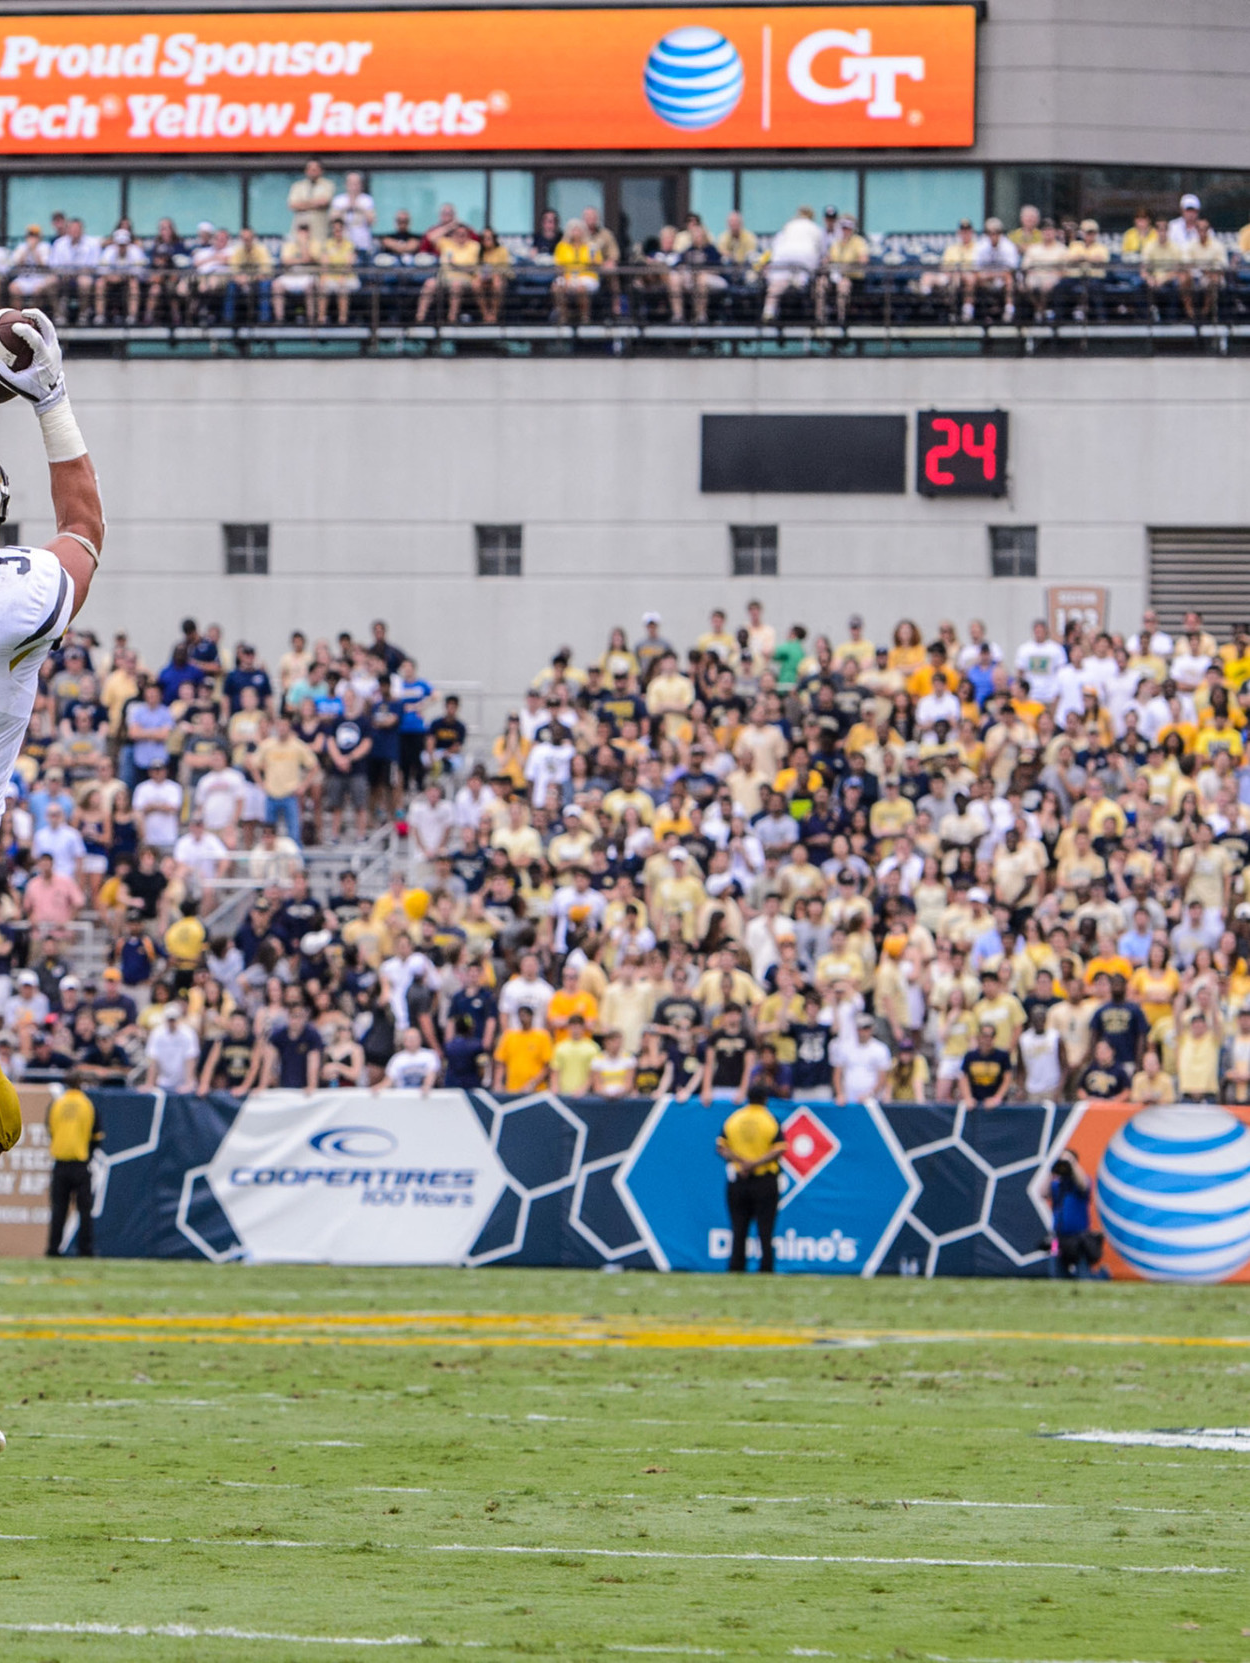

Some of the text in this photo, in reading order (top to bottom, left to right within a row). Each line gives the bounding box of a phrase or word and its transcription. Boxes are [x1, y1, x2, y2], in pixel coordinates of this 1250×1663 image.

[159, 33, 372, 85] Sponsor
[127, 94, 294, 137] Yellow
[925, 418, 997, 485] 24
[362, 1190, 474, 1207] 100 Years
[708, 1228, 858, 1262] Dmino's
